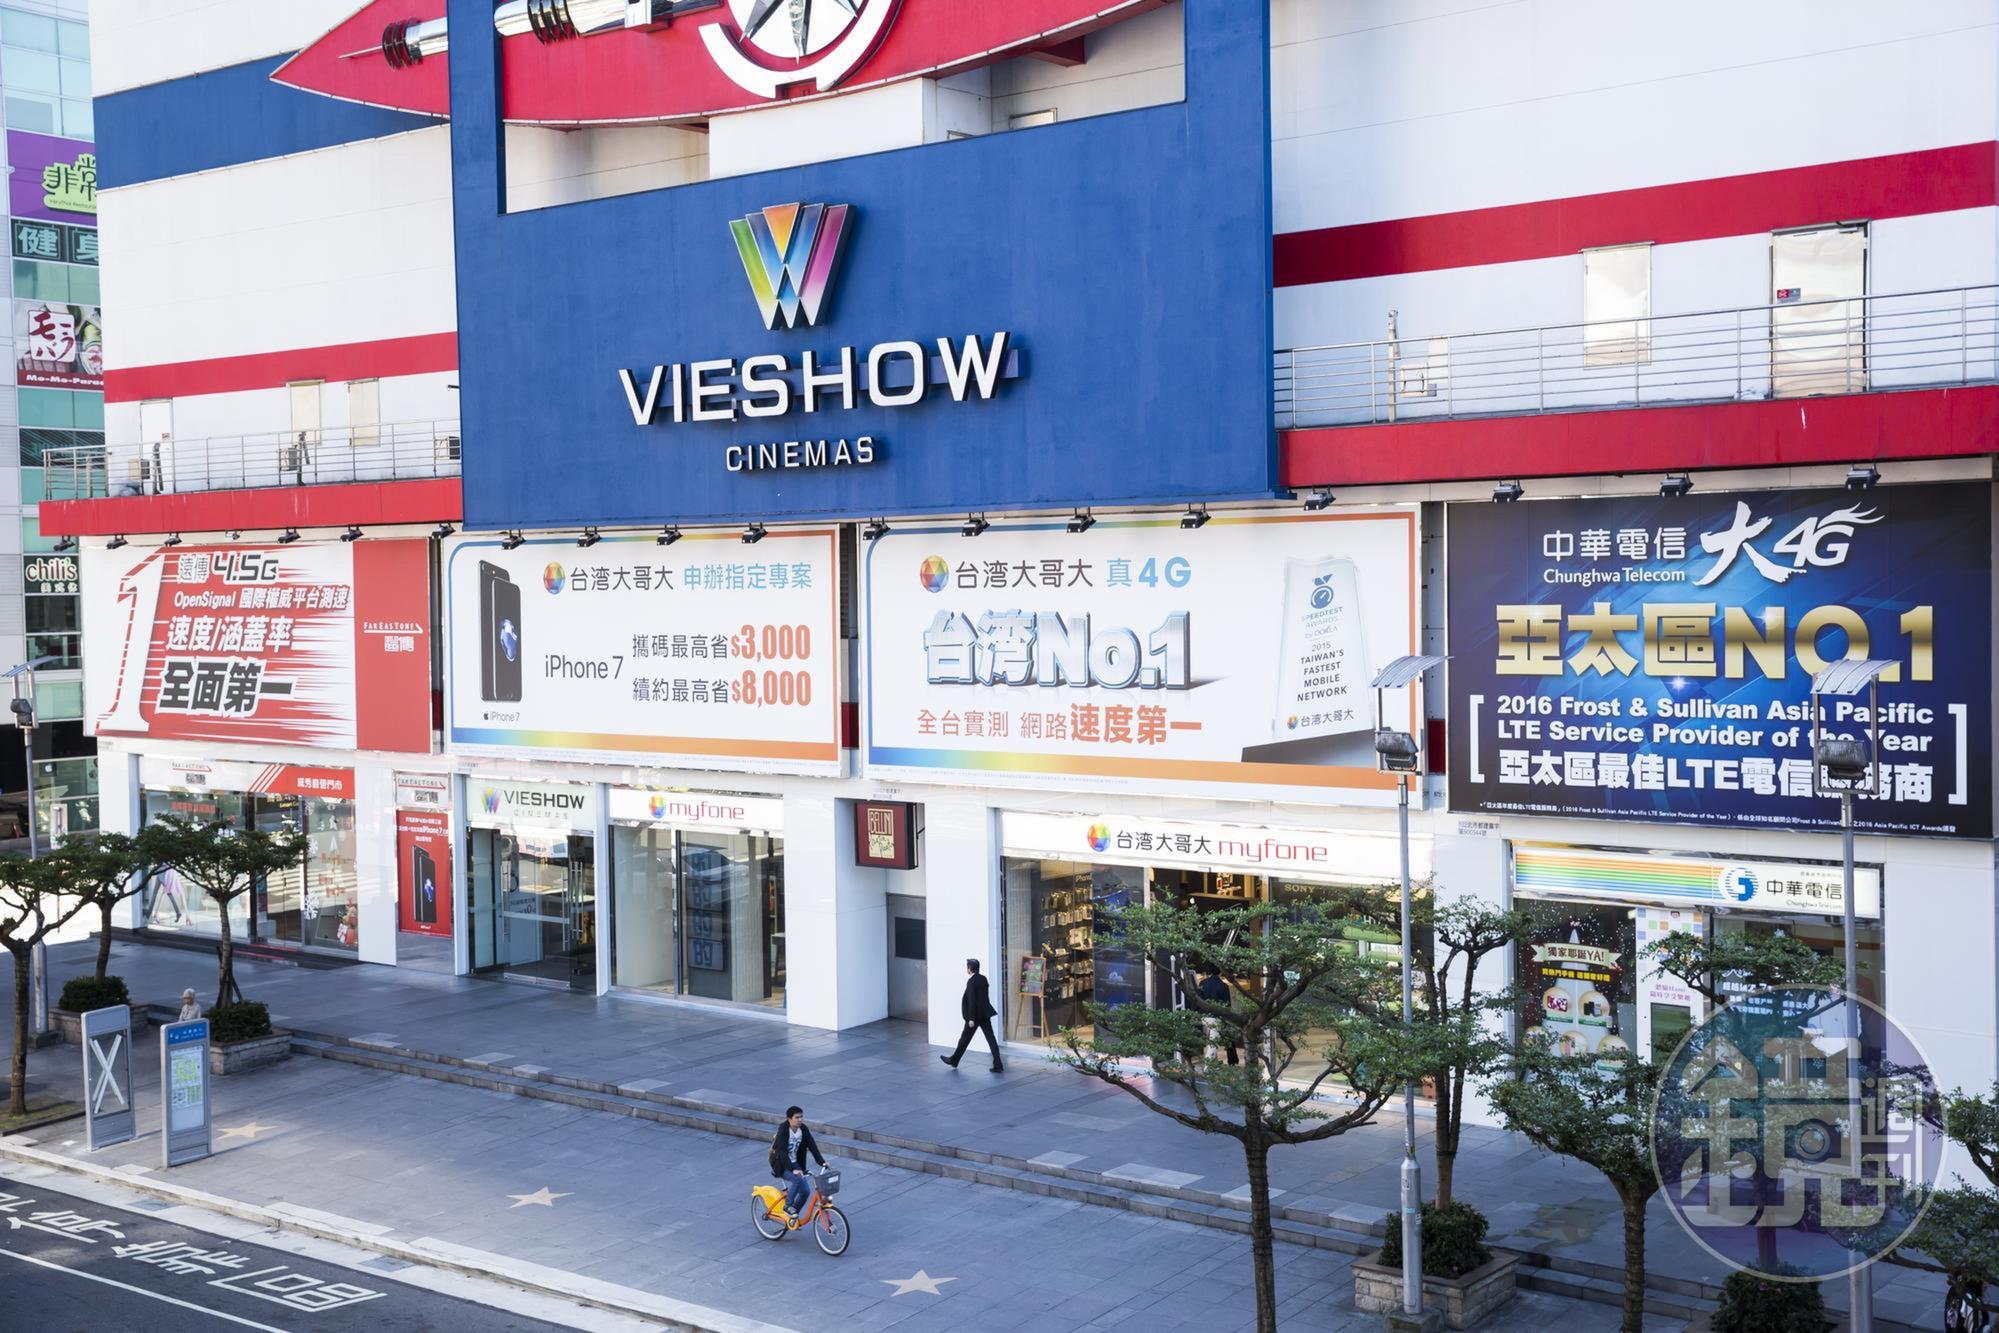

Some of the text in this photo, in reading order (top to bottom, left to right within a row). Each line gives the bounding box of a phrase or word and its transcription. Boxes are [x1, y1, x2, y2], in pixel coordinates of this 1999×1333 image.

[618, 331, 1010, 427] VIESHOW
[726, 436, 877, 473] CINEMAS
[1543, 500, 1884, 587] 中華電信 大4G
[26, 557, 78, 582] chili's
[212, 551, 279, 584] 4.5G
[570, 561, 813, 592] 台湾大哥大 申辦指定專案
[956, 558, 1094, 590] 台湾大哥大
[1543, 567, 1687, 587] Chunghwa Telecom
[174, 585, 351, 611] OpenSignal 國際權威平台測速
[166, 615, 296, 653] 速度/涵蓋率
[1311, 640, 1332, 652] 2015
[924, 608, 1192, 691] 台湾No.1
[1301, 648, 1344, 665] TAIWAN'S
[545, 654, 624, 682] iPhone 7
[1303, 661, 1341, 676] FASTEST
[1304, 673, 1340, 688] MOBILE
[157, 657, 296, 716] 全面第一
[1297, 685, 1347, 702] NETWORK
[490, 711, 515, 721] iPhone
[918, 701, 1203, 746] 全台實測 網路速度第一
[1497, 695, 1934, 725] 2016 Frost & Sullivan Asia Pacific
[1497, 720, 1541, 741] LTE
[1549, 721, 1644, 743] Service
[1653, 723, 1764, 748] Provider
[1772, 727, 1801, 748] of
[504, 789, 585, 810] VIESHOW
[669, 802, 745, 822] myfone
[1116, 829, 1329, 863] 台湾大哥大 myfone
[1284, 884, 1315, 893] SONY
[1767, 880, 1842, 900] 中華電信
[1547, 946, 1605, 963] 獨家耶誕YA!
